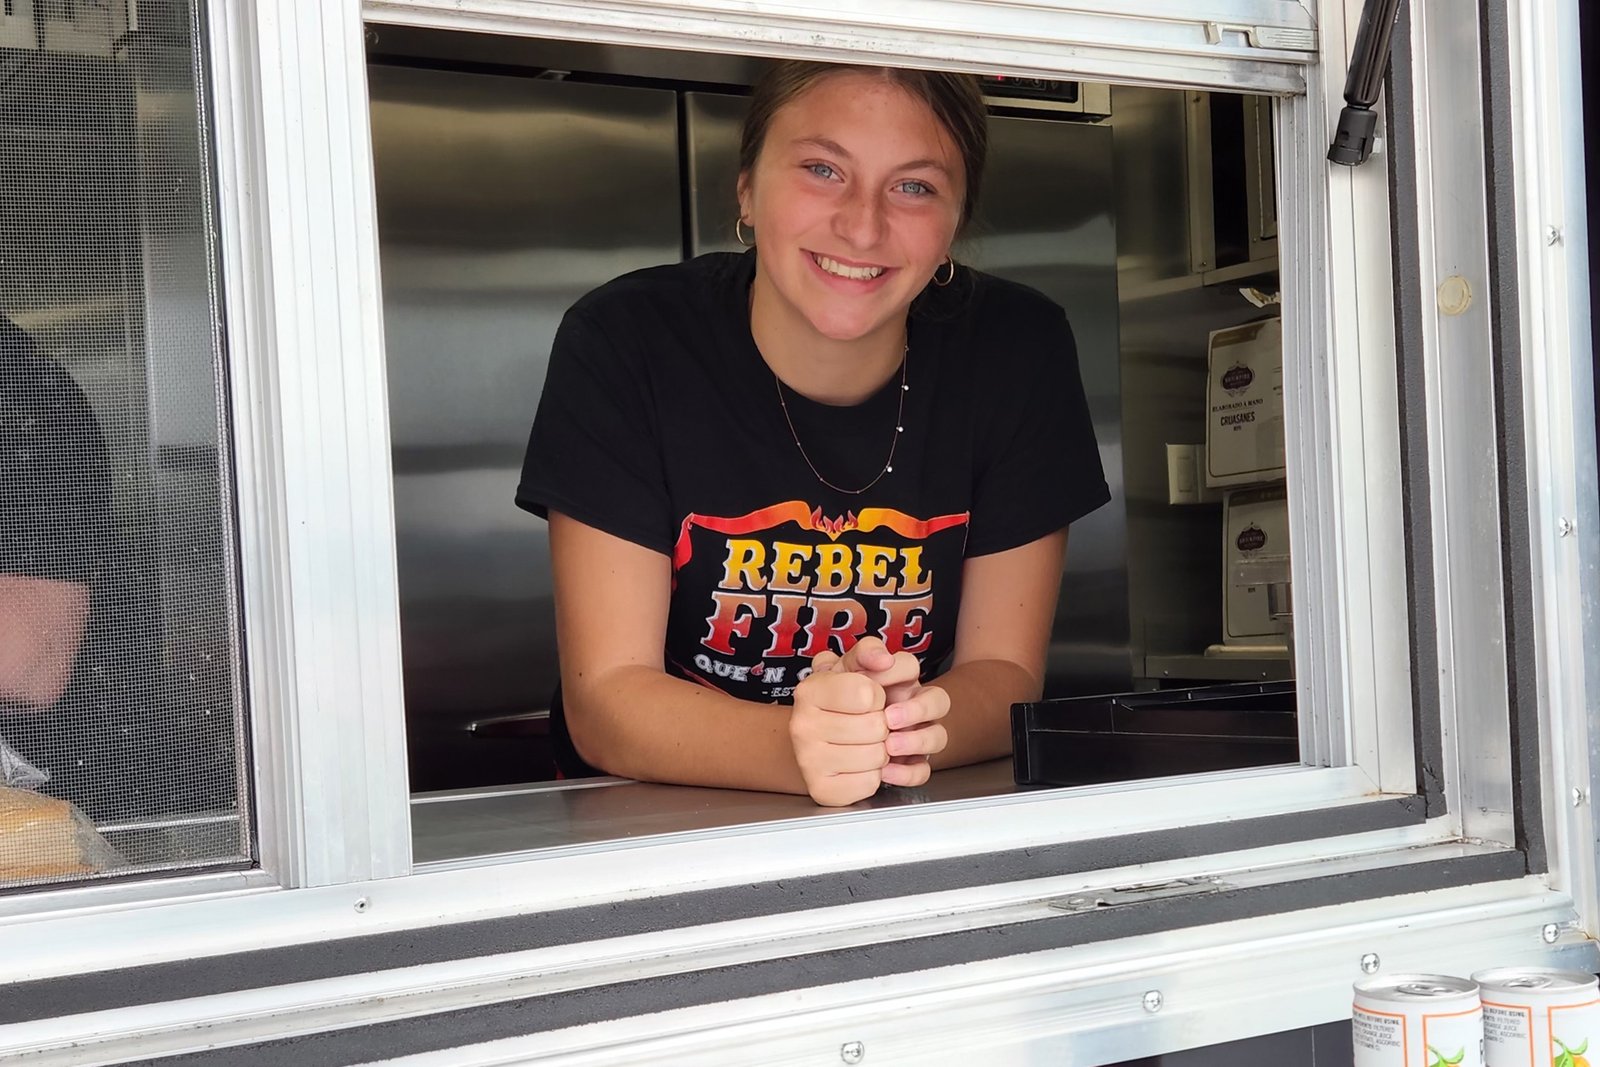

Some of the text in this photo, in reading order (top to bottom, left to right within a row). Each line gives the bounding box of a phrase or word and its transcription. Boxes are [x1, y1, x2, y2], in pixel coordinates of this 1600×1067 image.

[1221, 411, 1255, 426] CRUASANES
[718, 538, 933, 596] REBEL
[700, 591, 934, 658] FIRE
